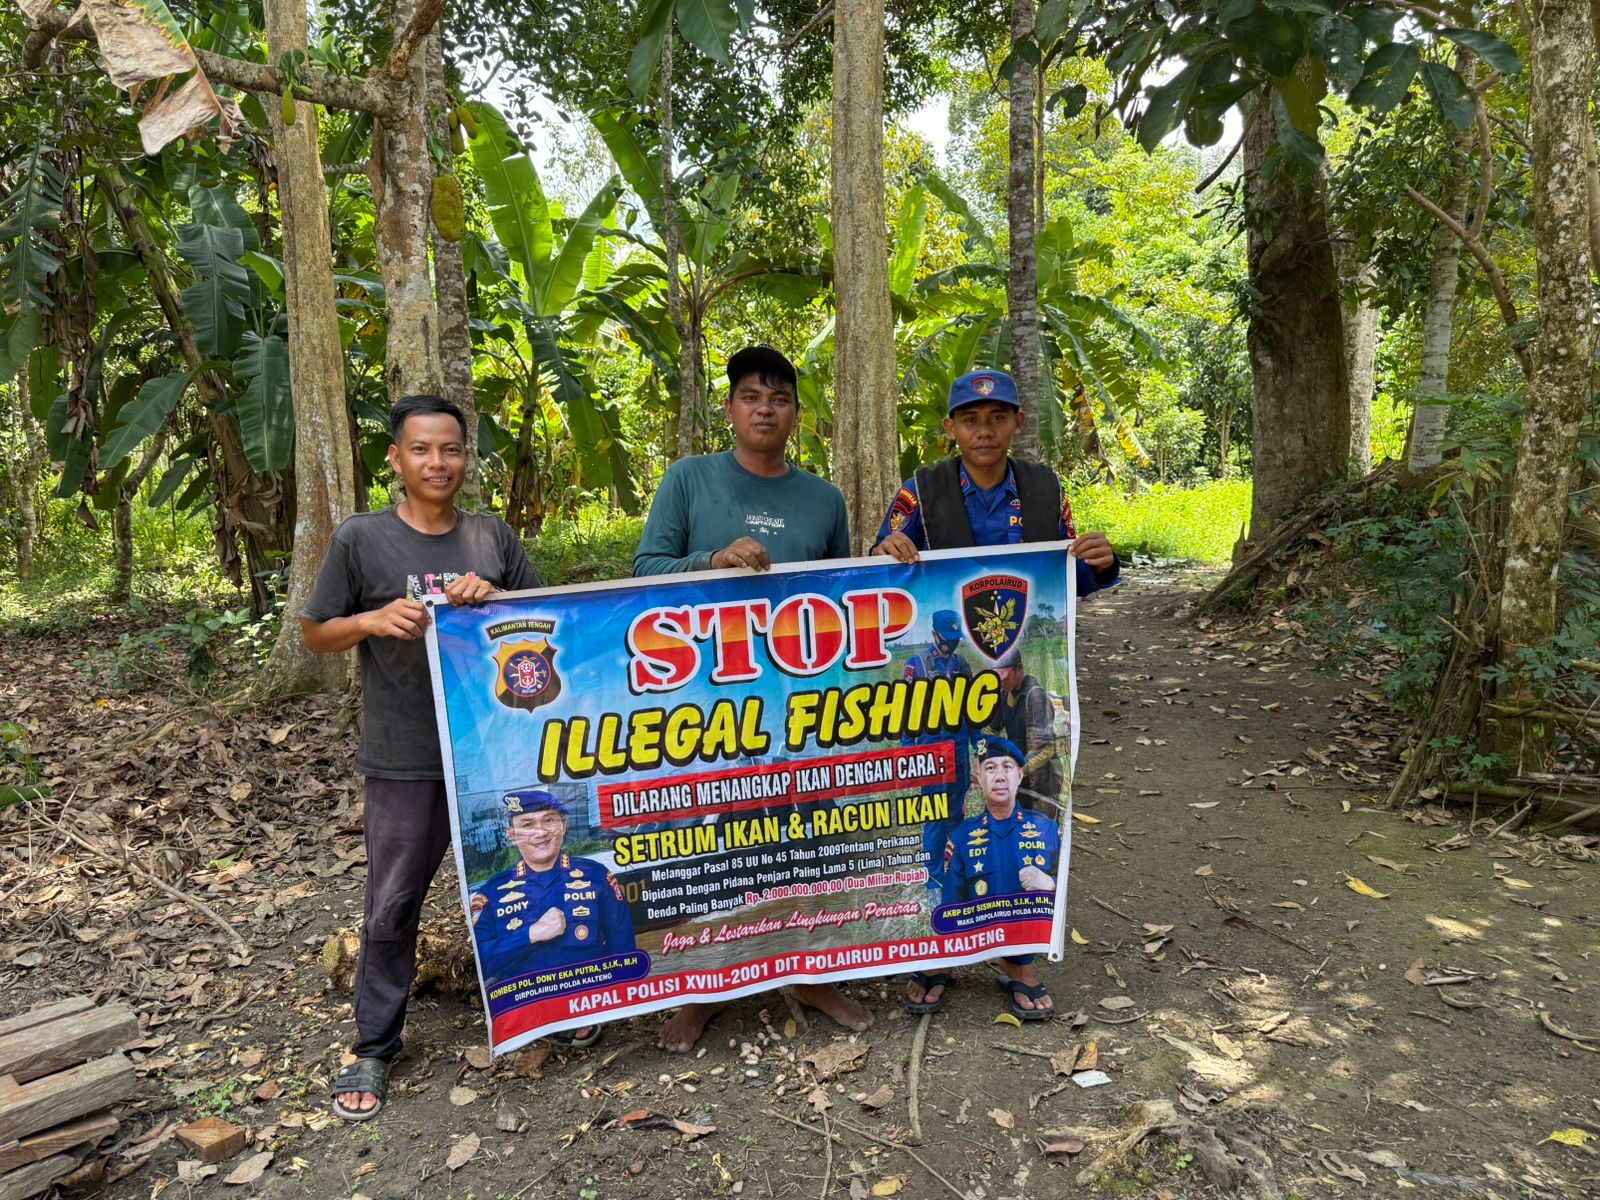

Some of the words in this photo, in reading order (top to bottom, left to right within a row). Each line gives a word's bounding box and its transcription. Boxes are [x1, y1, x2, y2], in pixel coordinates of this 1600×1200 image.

[968, 577, 1023, 592] KORPOLAIRUD
[490, 622, 527, 635] KALIMANTAN
[528, 621, 551, 630] TENGAH
[629, 587, 917, 695] STOP
[540, 698, 769, 780] ILLEGAL
[788, 671, 999, 750] FISHING
[612, 786, 692, 817] DILARANG
[696, 771, 791, 805] MENANGKAP
[796, 766, 831, 792] IKAN
[835, 758, 893, 787] DENGAN
[614, 825, 717, 866] SETRUM
[724, 816, 780, 849] IKAN
[787, 812, 806, 840] &
[812, 801, 892, 837] RACUN
[897, 792, 949, 825] IKAN
[1019, 841, 1046, 850] POLRI
[652, 867, 701, 882] Melanggar
[704, 860, 729, 874] Pasal
[731, 857, 743, 869] 85
[745, 856, 759, 868] UU
[761, 853, 773, 865] No
[775, 850, 787, 863] 45
[790, 848, 816, 860] Tahun
[818, 841, 875, 857] 2009Tentang
[877, 835, 920, 849] Perikanan
[969, 847, 987, 858] EDY
[564, 891, 596, 901] POLRI
[642, 885, 684, 902] Dipidana
[686, 881, 721, 897] Dengan
[723, 875, 754, 889] Pidana
[757, 870, 790, 884] Penjara
[793, 865, 821, 879] Paling
[823, 861, 847, 875] Lama
[848, 859, 855, 871] 5
[858, 856, 885, 872] (Lima)
[887, 853, 913, 867] Tahun
[915, 851, 931, 863] dan
[648, 905, 677, 920] Denda
[680, 900, 709, 916] Paling
[711, 893, 744, 910] Banyak
[745, 891, 763, 906] Rp.
[763, 879, 843, 902] 2.000.000.000,00
[844, 877, 865, 893] (Dua
[867, 872, 893, 886] Miliar
[895, 867, 929, 884] Rupiah)
[497, 901, 529, 917] DONY
[662, 932, 696, 955] Jaga
[700, 927, 712, 944] &
[714, 917, 784, 943] Lestarikan
[785, 908, 861, 933] Lingkungan
[864, 901, 921, 920] Perairan
[943, 910, 961, 918] AKBP
[962, 907, 975, 916] EDY
[976, 900, 1013, 911] SISWANTO,
[1013, 897, 1034, 906] S.I.K.,
[956, 918, 975, 926] WAKIL
[975, 911, 1011, 922] DIRPOLAIRUD
[1012, 908, 1031, 916] POLDA
[490, 983, 517, 1000] KOMBES
[518, 977, 535, 988] POL.
[536, 973, 557, 984] DONY
[558, 969, 574, 980] EKA
[575, 964, 601, 977] PUTRA,
[602, 960, 623, 972] S.I.K.,
[624, 957, 638, 966] M.H
[514, 984, 558, 1001] DIRPOLAIRUD
[559, 980, 581, 990] POLDA
[582, 973, 612, 987] KALTENG
[568, 992, 622, 1014] KAPAL
[626, 979, 680, 1002] POLISI
[685, 962, 769, 990] XVIII-2001
[774, 955, 800, 974] DIT
[805, 947, 883, 970] POLAIRUD
[888, 940, 940, 960] POLDA
[944, 928, 1005, 954] KALTENG
